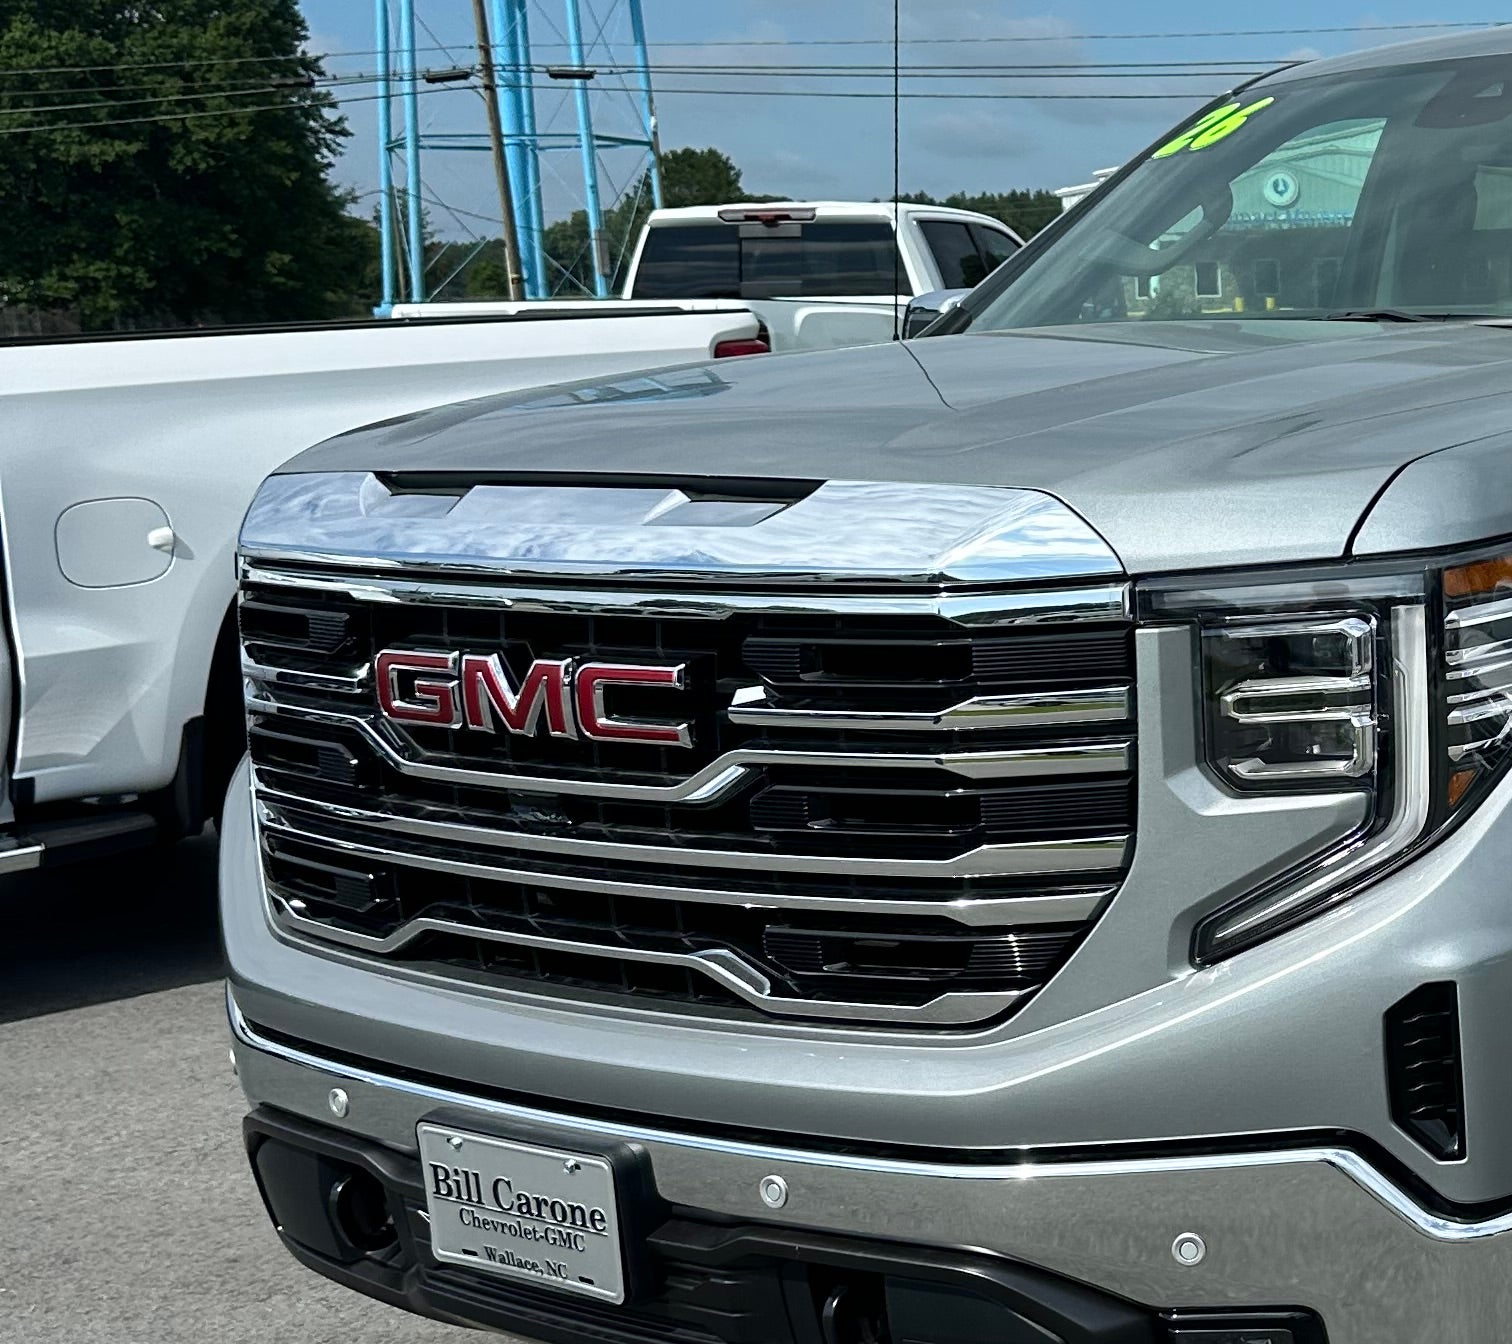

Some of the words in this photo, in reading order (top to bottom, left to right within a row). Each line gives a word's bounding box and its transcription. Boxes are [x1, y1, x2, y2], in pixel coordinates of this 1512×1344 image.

[375, 648, 694, 749] GMC
[429, 1161, 486, 1206] Bill
[492, 1176, 607, 1232] Carone
[459, 1207, 586, 1252] Chevrolet-GMC
[484, 1245, 544, 1276] Wallace,
[545, 1259, 569, 1280] NC
